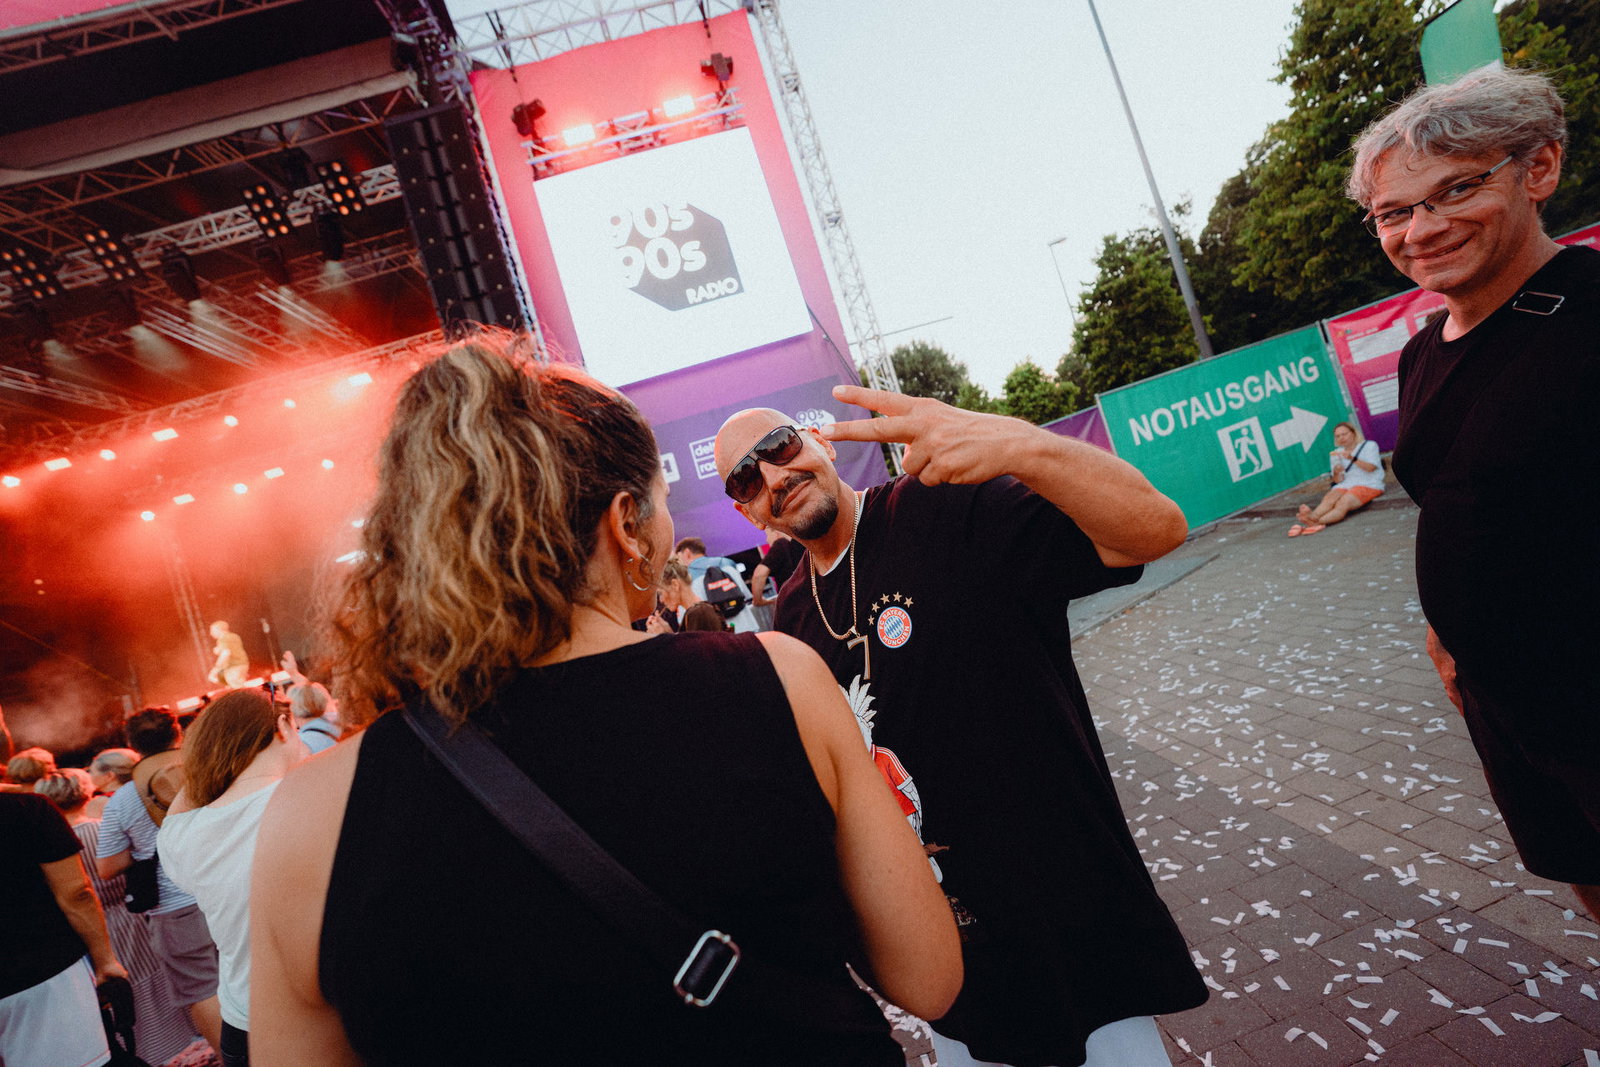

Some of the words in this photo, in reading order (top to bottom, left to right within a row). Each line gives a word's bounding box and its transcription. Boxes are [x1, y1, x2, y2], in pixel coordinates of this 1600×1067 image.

[600, 199, 694, 248] 90s
[612, 237, 707, 289] 90s
[686, 277, 738, 304] RADIO
[1128, 356, 1320, 446] NOTAUSGANG
[882, 609, 907, 620] BAYERN
